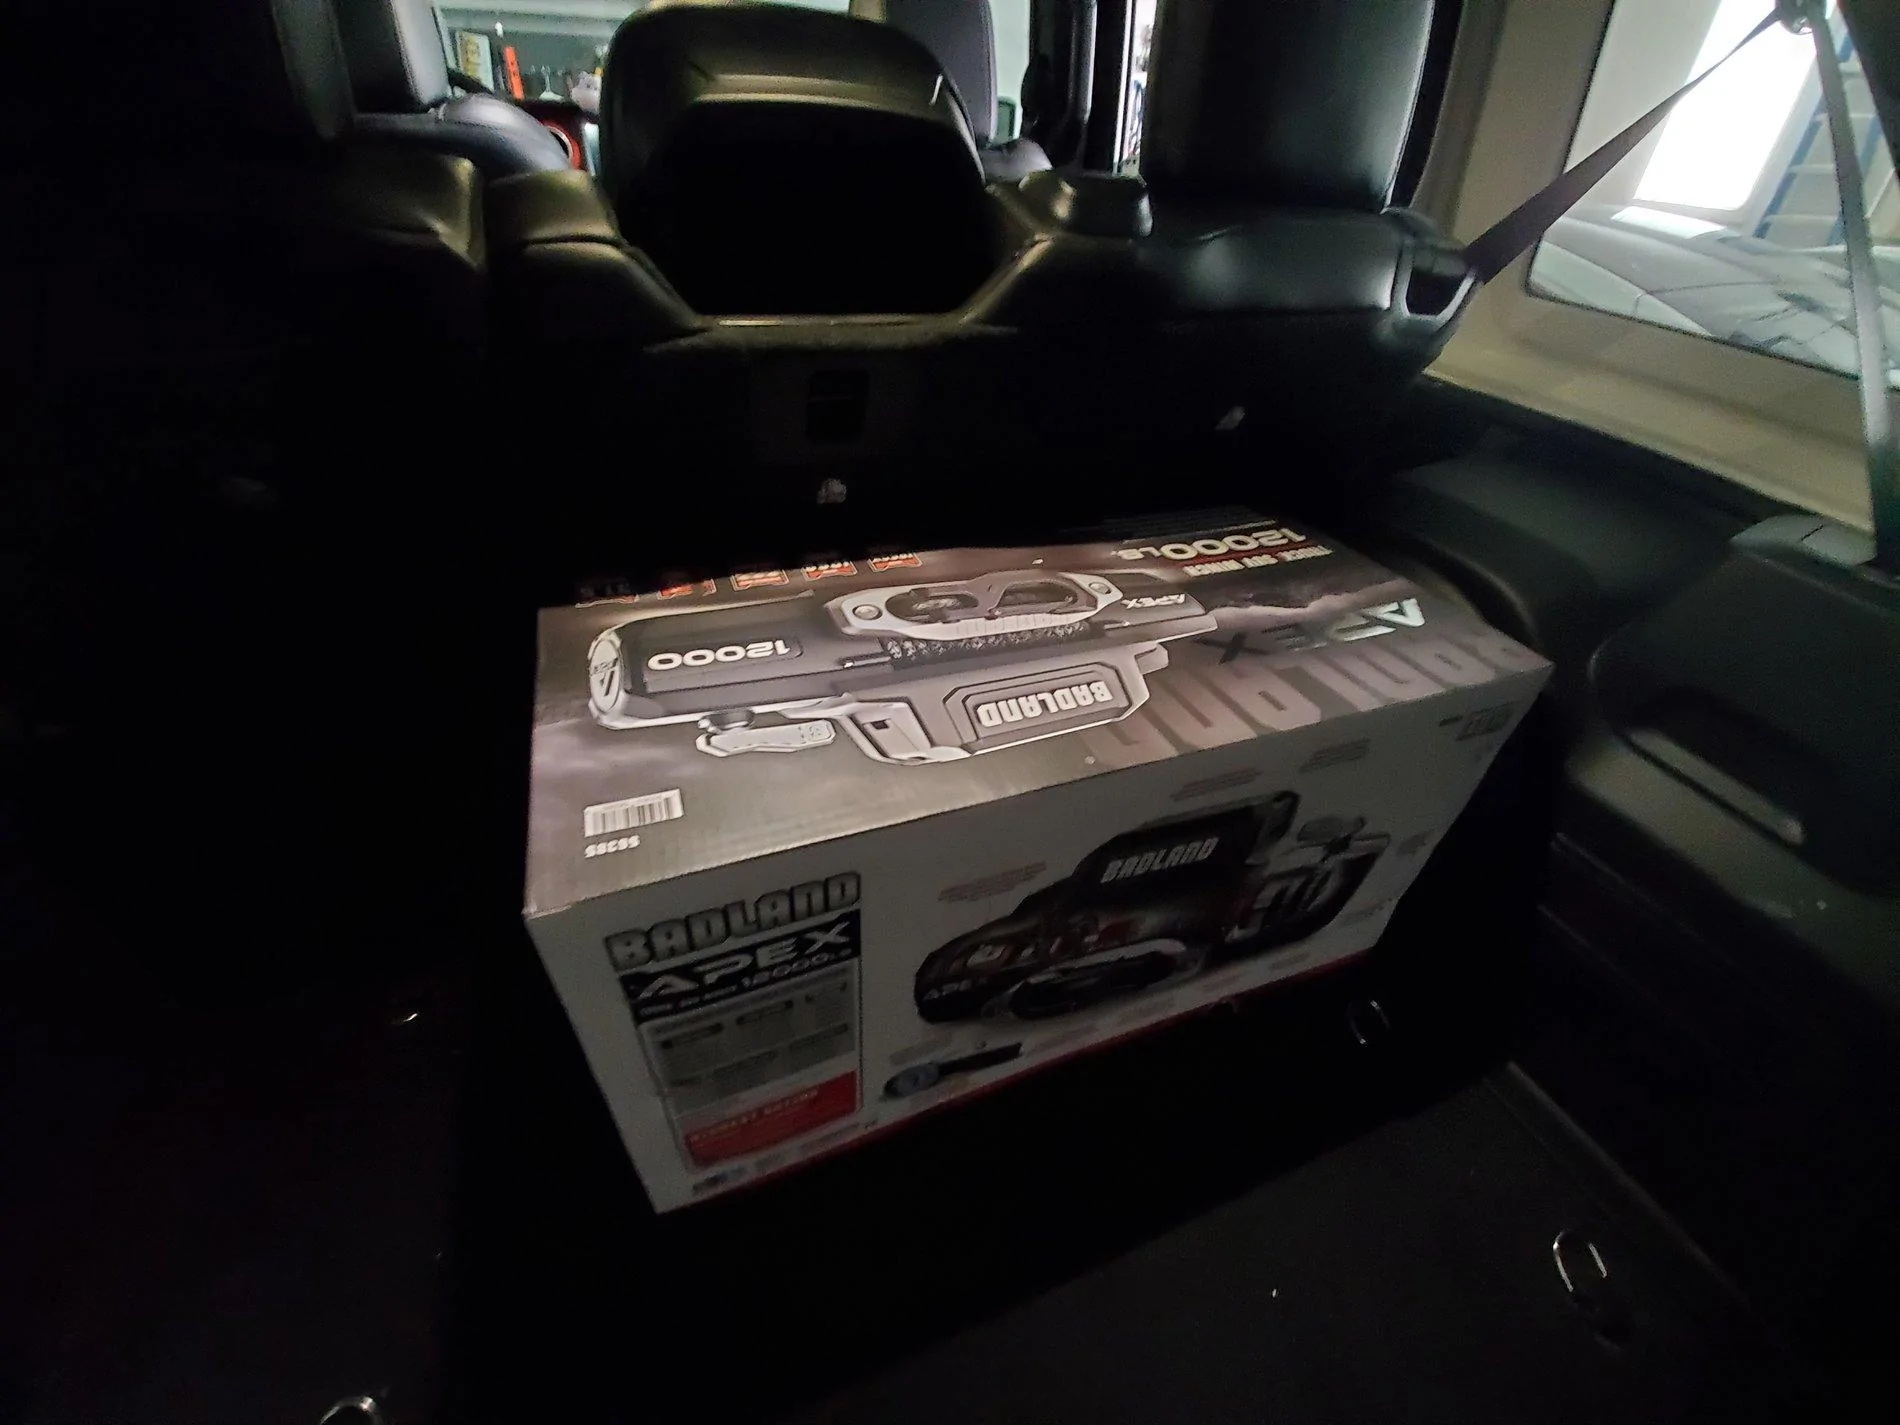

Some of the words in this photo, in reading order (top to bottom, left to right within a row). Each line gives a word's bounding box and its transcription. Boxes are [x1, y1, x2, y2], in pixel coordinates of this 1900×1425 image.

[1122, 593, 1187, 611] APEX
[647, 638, 792, 672] 12000
[978, 680, 1112, 728] BADLAND
[1100, 838, 1221, 884] BADLAND
[606, 870, 861, 971] BADLAND
[636, 921, 850, 1001] APEX
